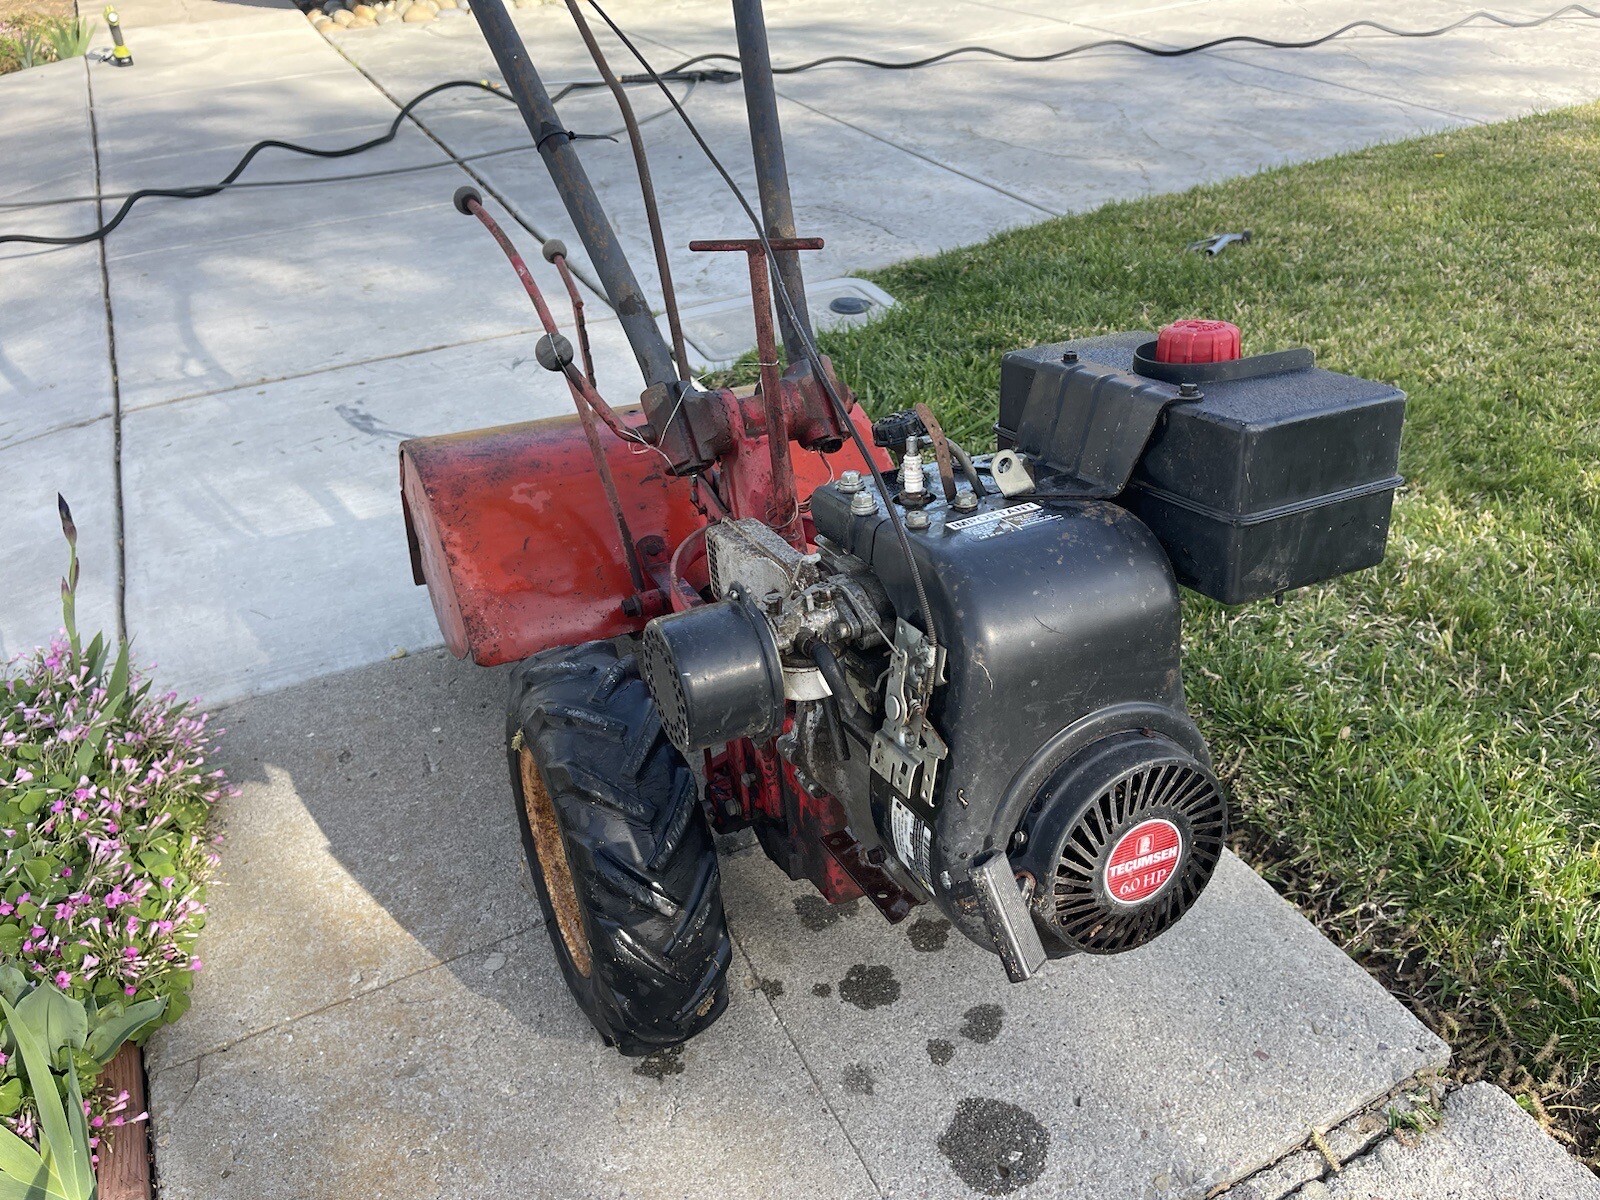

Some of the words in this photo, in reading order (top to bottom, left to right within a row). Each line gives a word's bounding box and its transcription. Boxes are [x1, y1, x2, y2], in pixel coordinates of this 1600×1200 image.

[950, 504, 1035, 528] IMPORTANT
[1109, 845, 1178, 877] TECUMSEH
[1119, 877, 1140, 895] 6.0
[1142, 868, 1167, 888] HP
